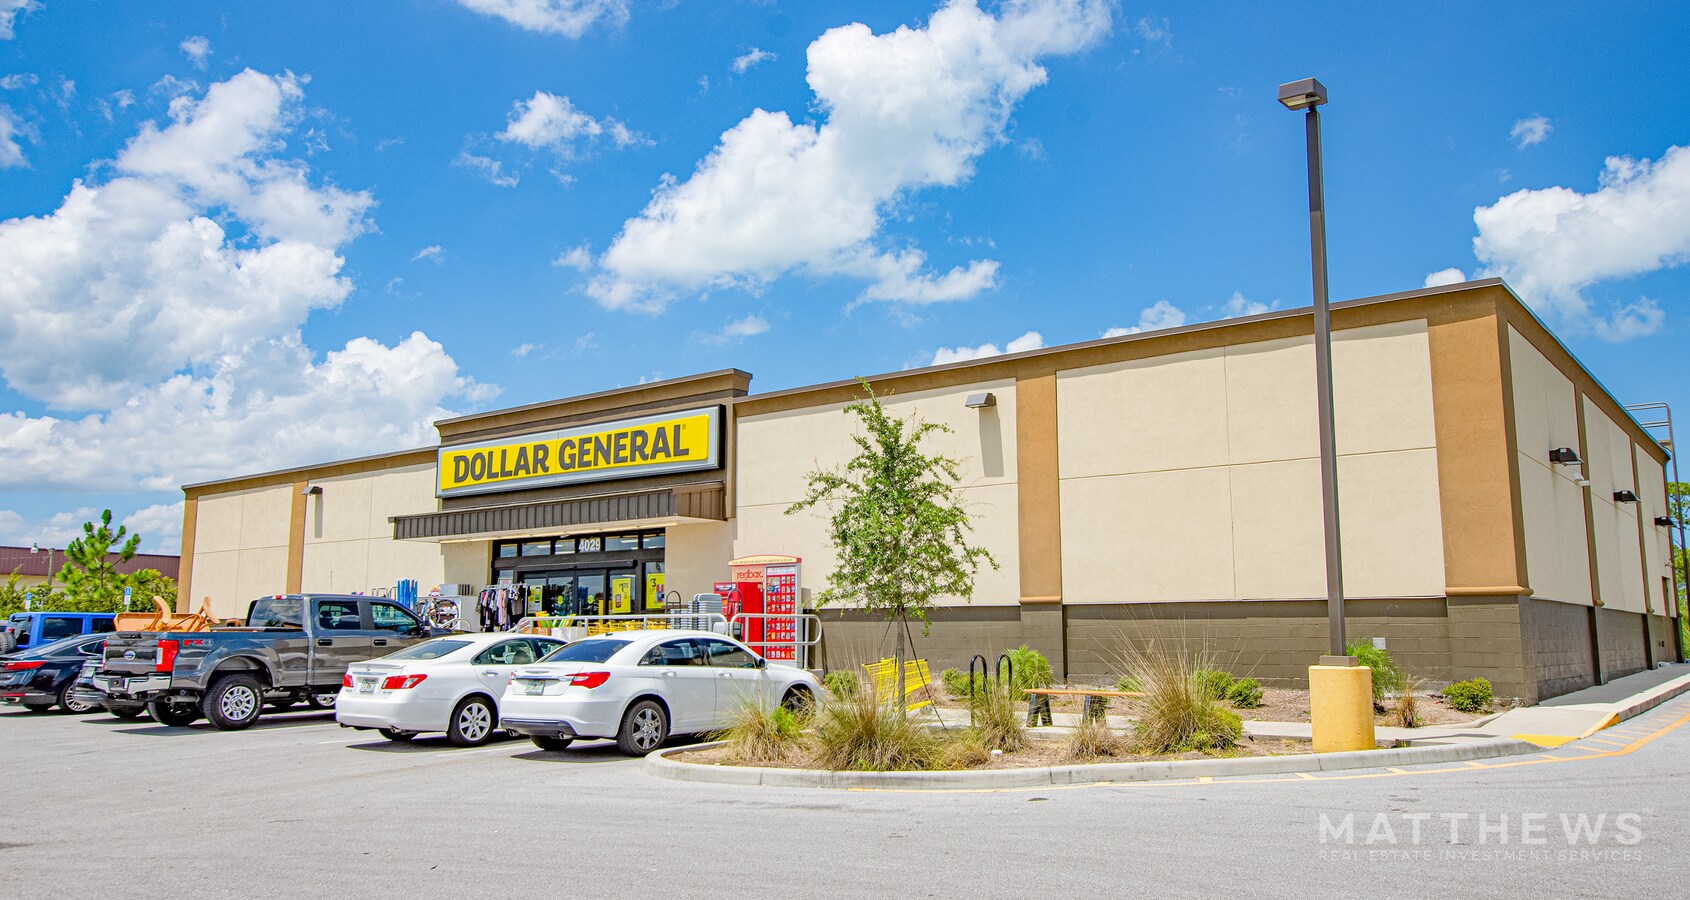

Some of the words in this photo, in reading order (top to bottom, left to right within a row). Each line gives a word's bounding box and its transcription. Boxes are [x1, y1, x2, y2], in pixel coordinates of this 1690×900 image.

[453, 443, 550, 483] DOLLAR
[558, 424, 690, 471] GENERAL
[578, 537, 601, 553] 4029
